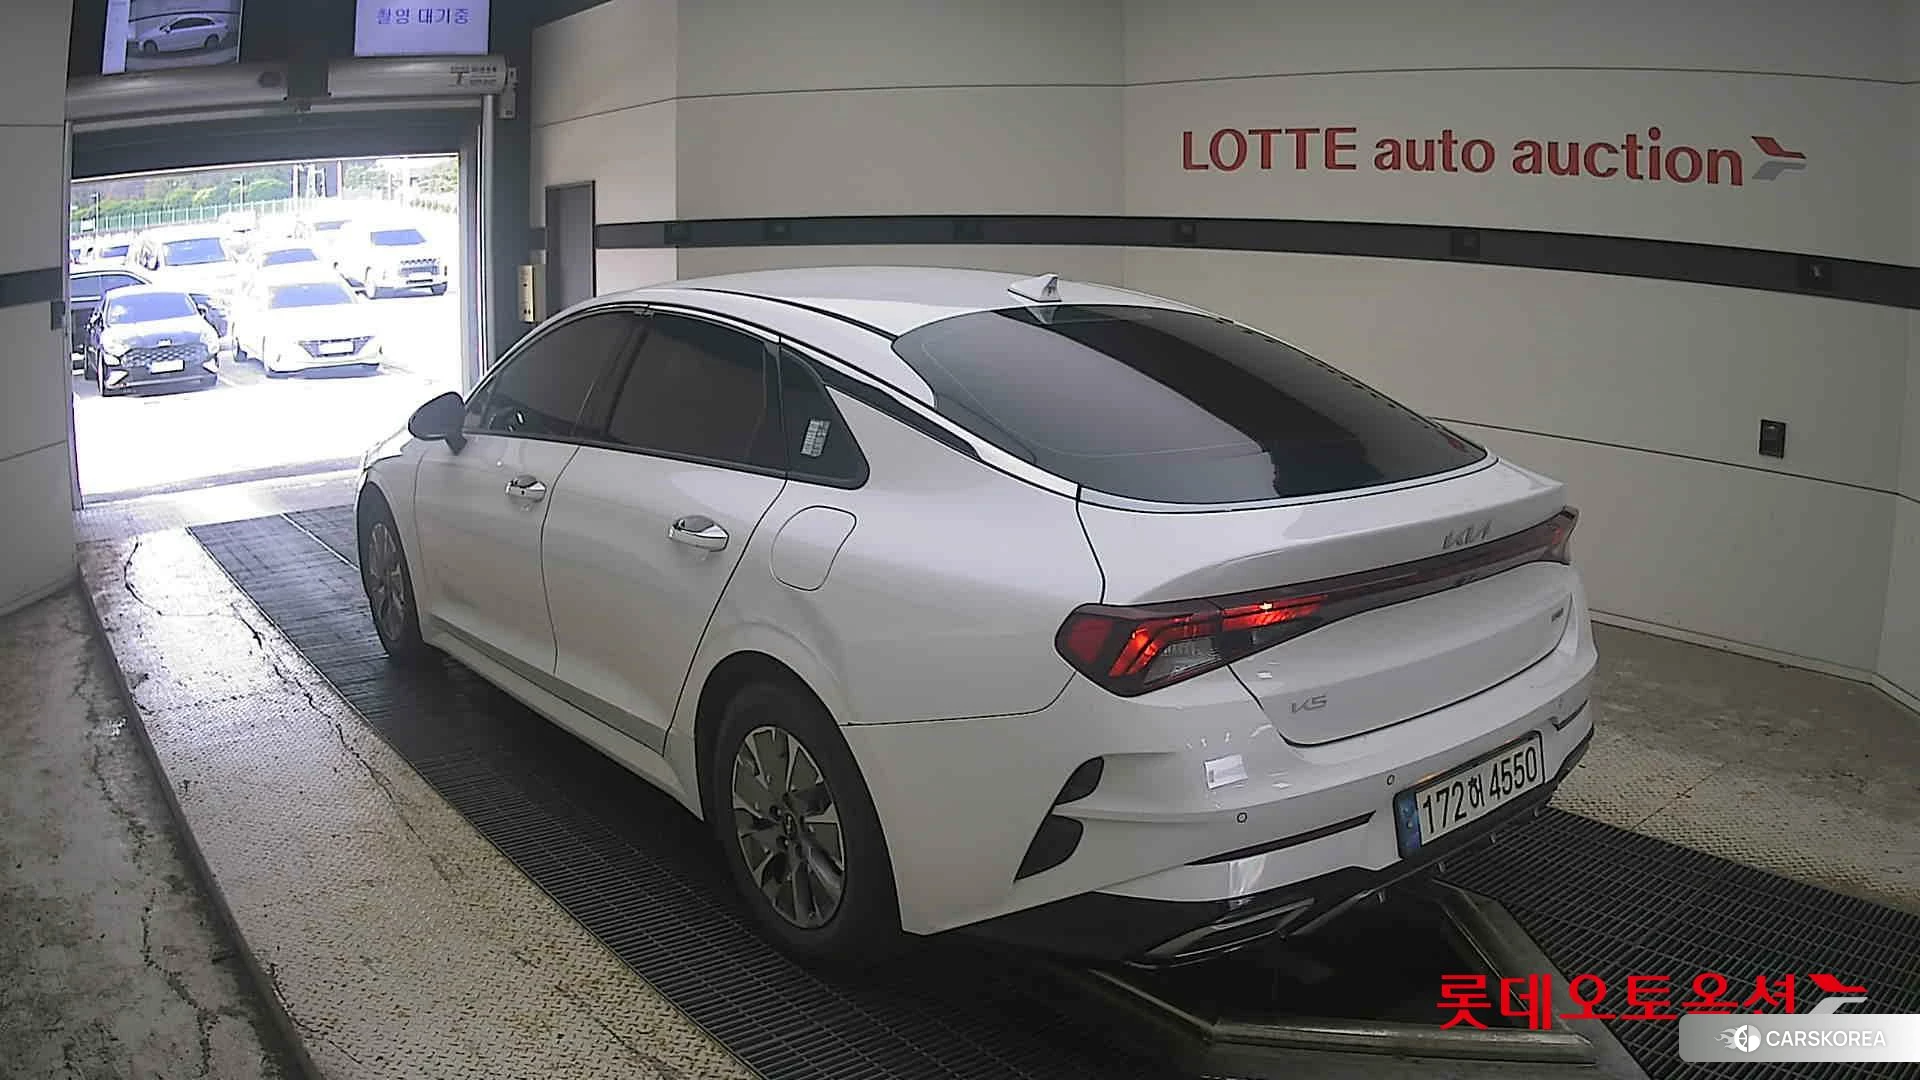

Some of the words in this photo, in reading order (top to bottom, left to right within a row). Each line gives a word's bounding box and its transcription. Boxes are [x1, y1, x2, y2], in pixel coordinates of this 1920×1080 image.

[418, 8, 470, 24] 대기중
[1183, 127, 1358, 171] LOTTE
[1374, 128, 1496, 174] auto
[1511, 126, 1745, 187] auction
[1489, 746, 1538, 800] 4550
